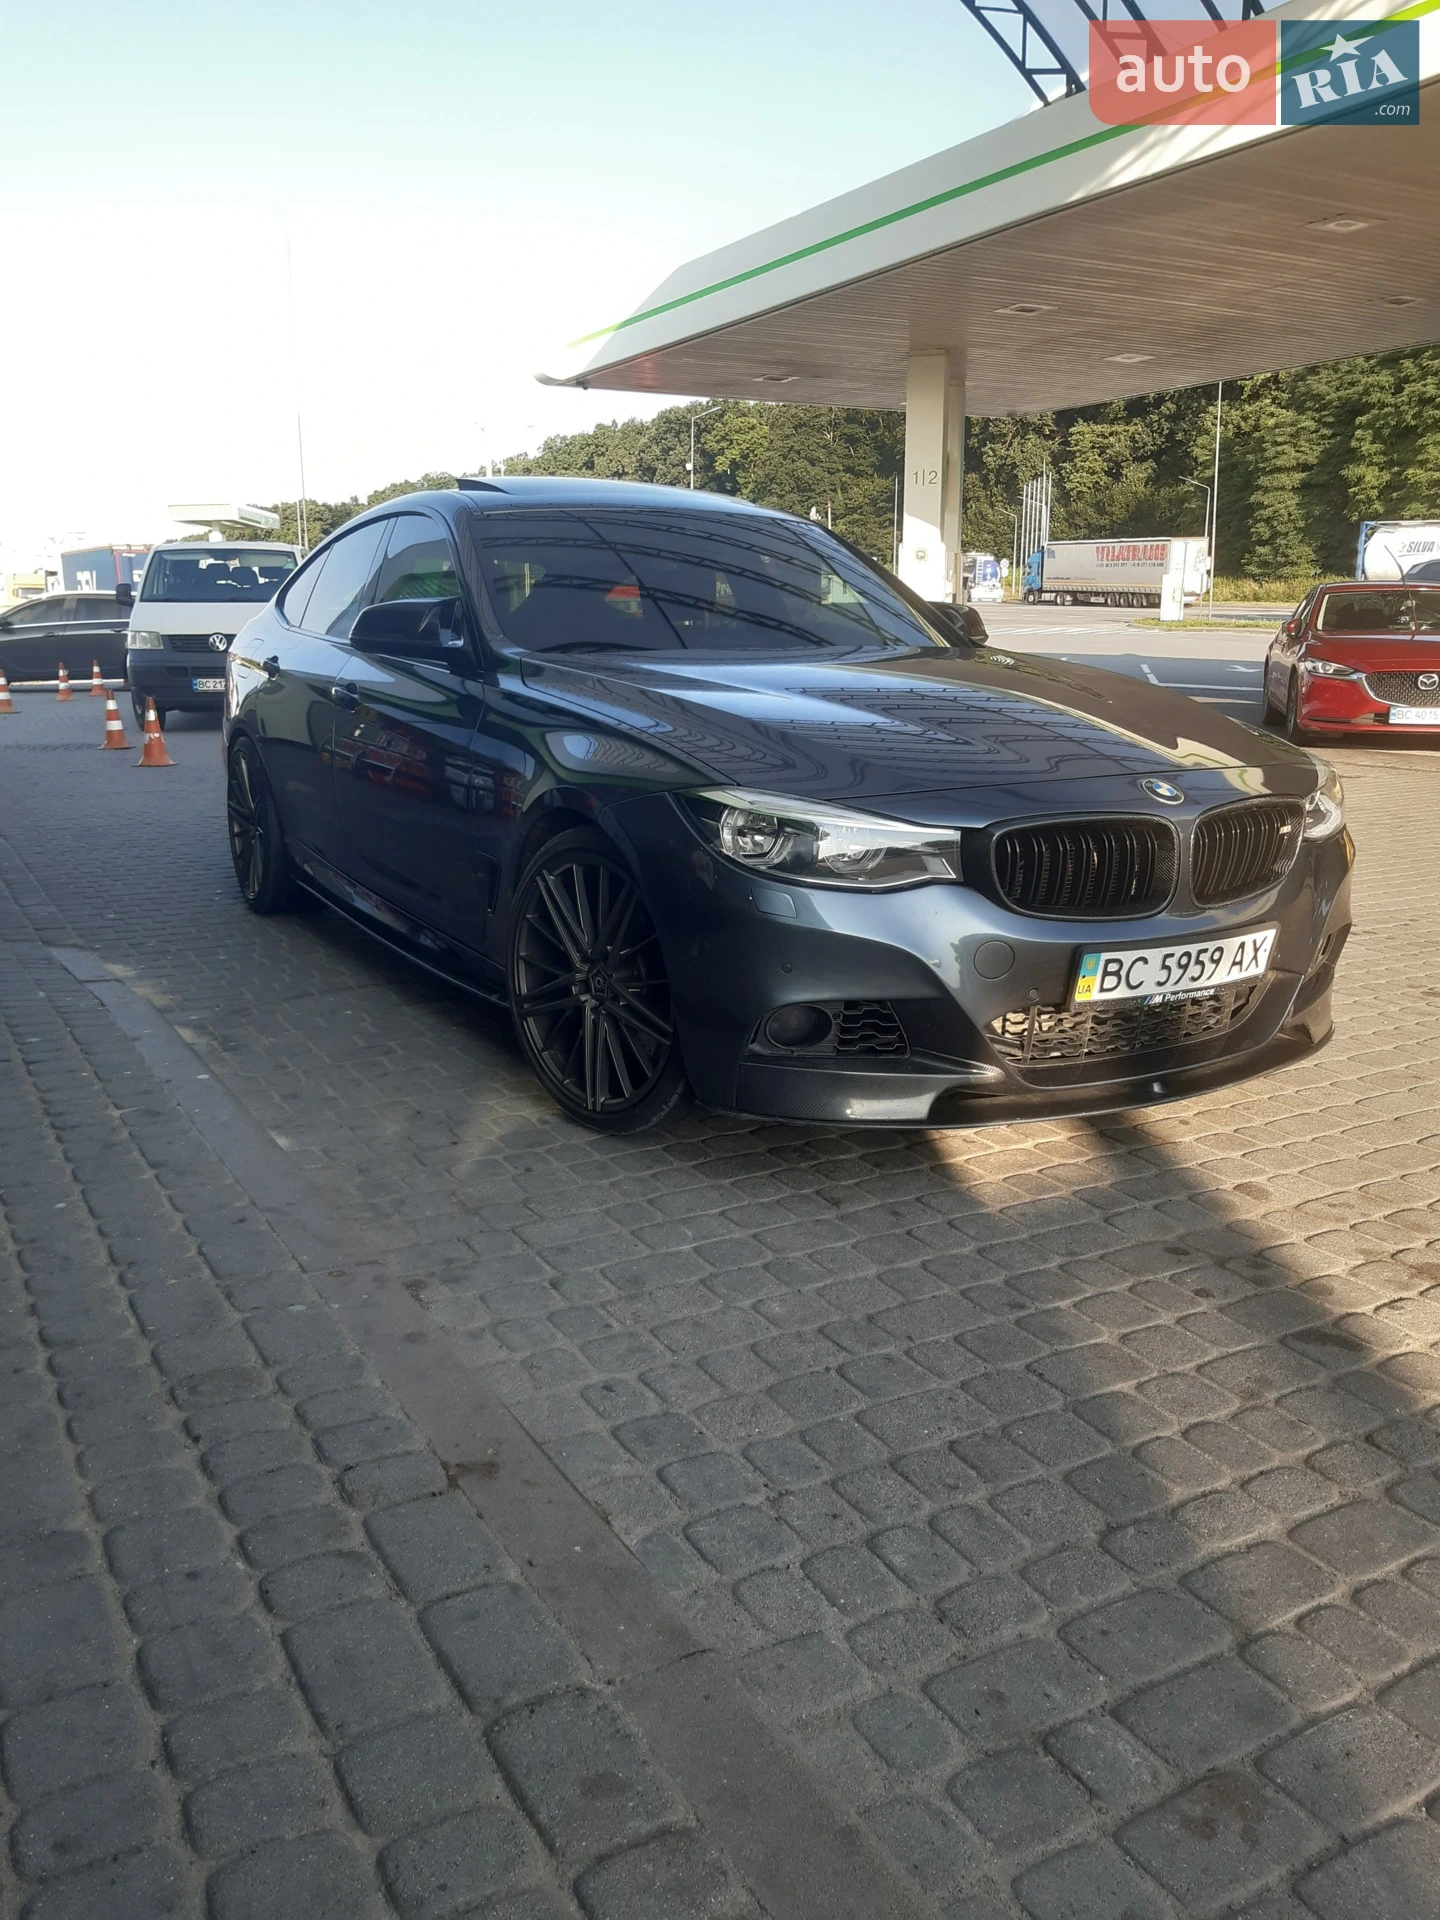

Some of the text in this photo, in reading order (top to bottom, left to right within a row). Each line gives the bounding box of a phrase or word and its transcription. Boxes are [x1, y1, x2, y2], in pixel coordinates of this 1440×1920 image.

[1406, 541, 1435, 553] SILVA
[198, 680, 212, 689] BC
[1396, 709, 1412, 720] BC
[1099, 936, 1268, 993] BC 5959 AX
[1077, 984, 1092, 995] UA
[1164, 988, 1215, 1003] Performance
